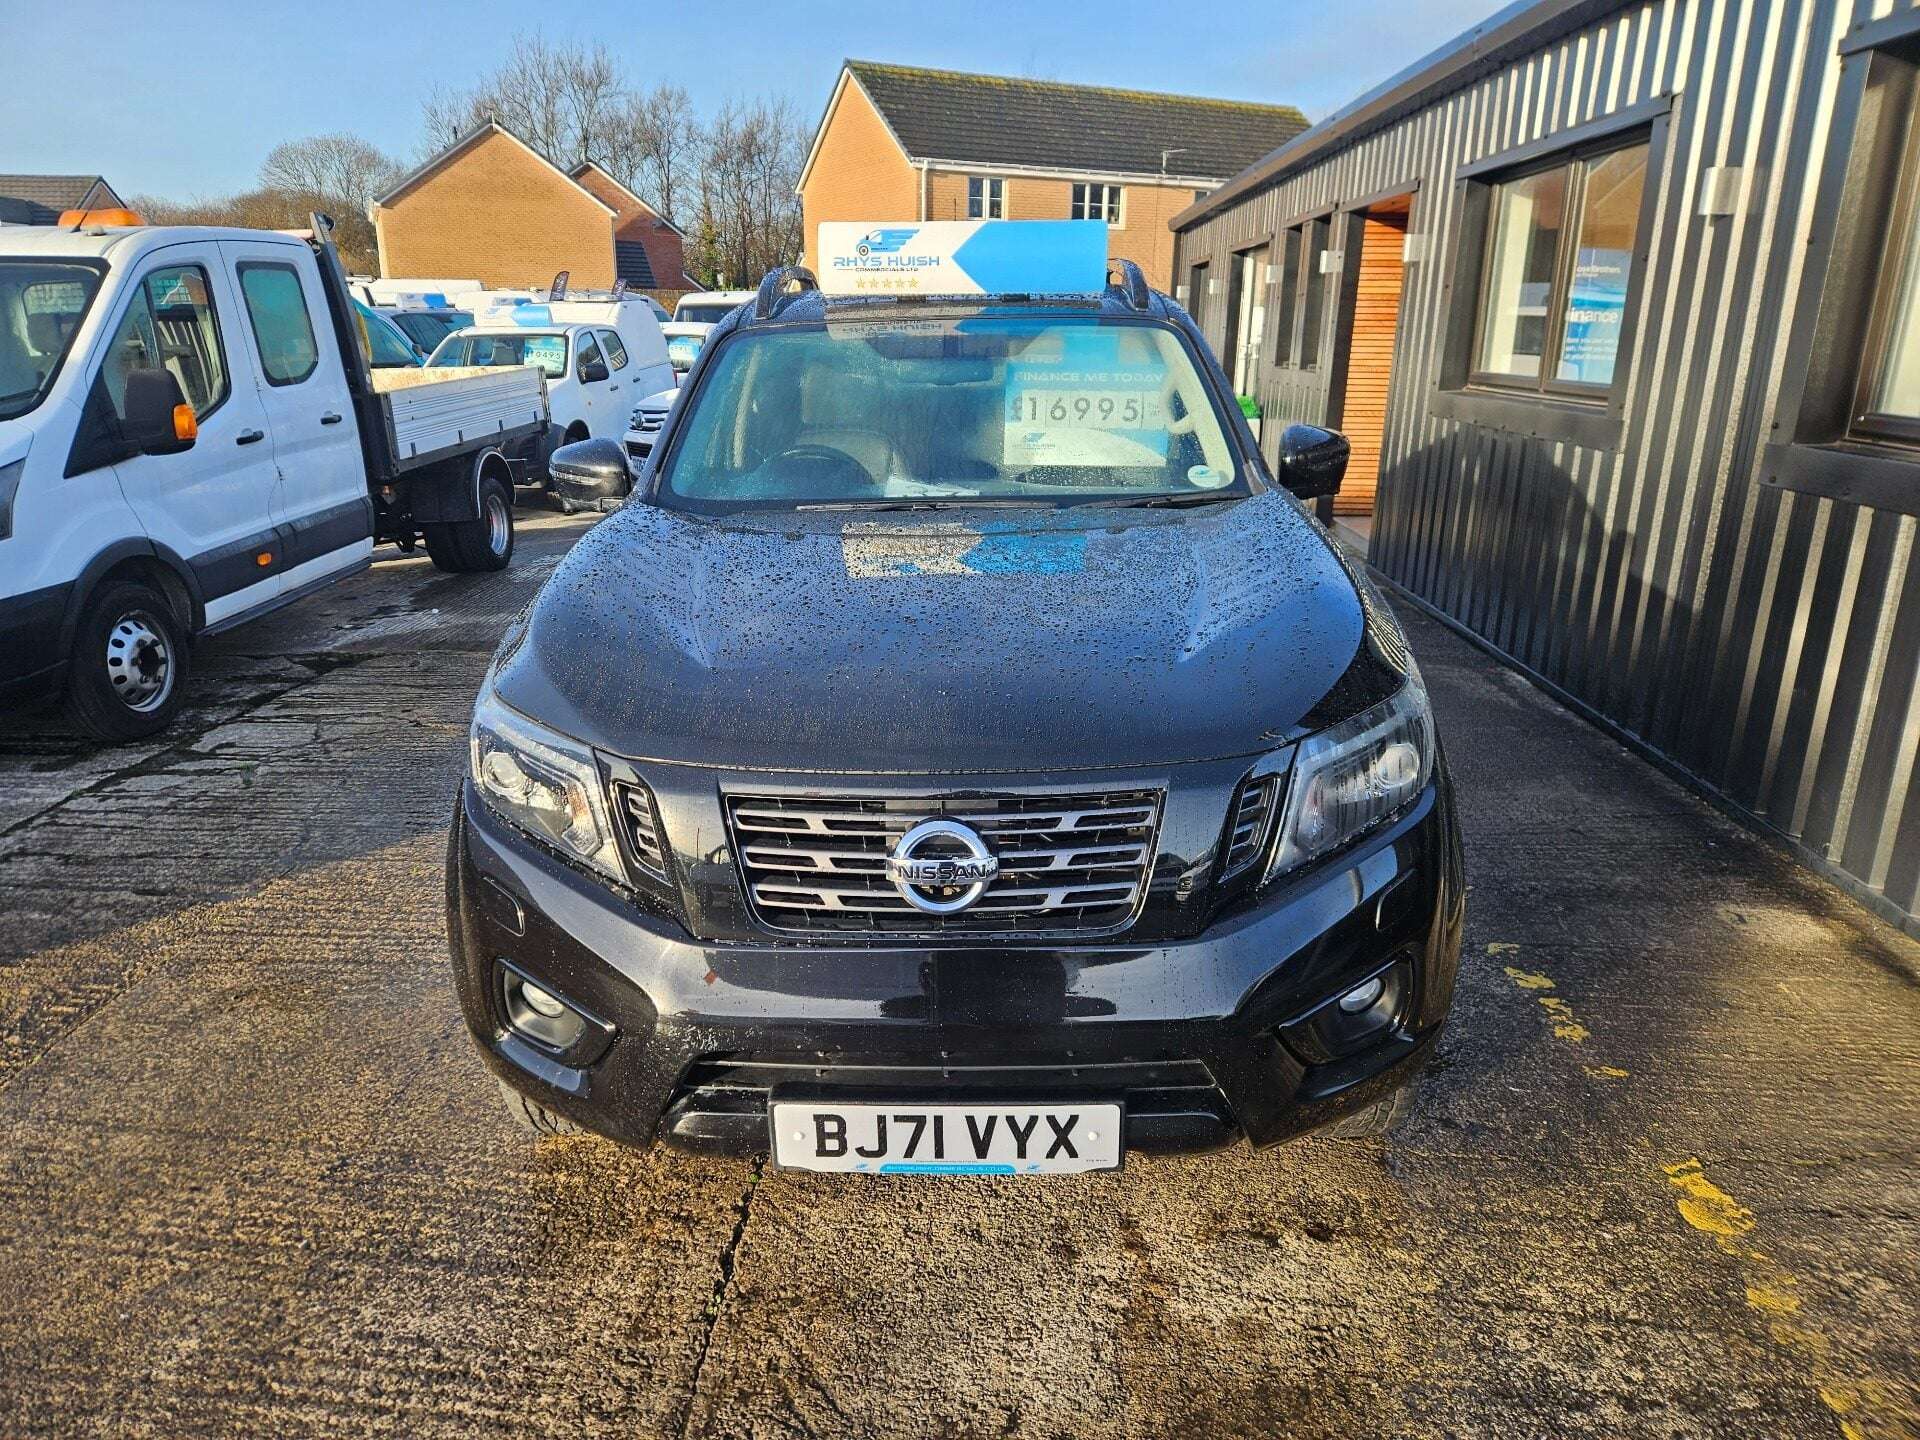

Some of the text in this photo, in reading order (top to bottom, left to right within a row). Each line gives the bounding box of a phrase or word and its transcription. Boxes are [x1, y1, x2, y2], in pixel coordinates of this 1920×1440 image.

[833, 255, 940, 267] RHYS HUISH
[1014, 371, 1162, 382] FINANCE ME TODAY
[896, 864, 988, 880] NISSAN
[813, 1113, 1080, 1160] BJ71 VYX
